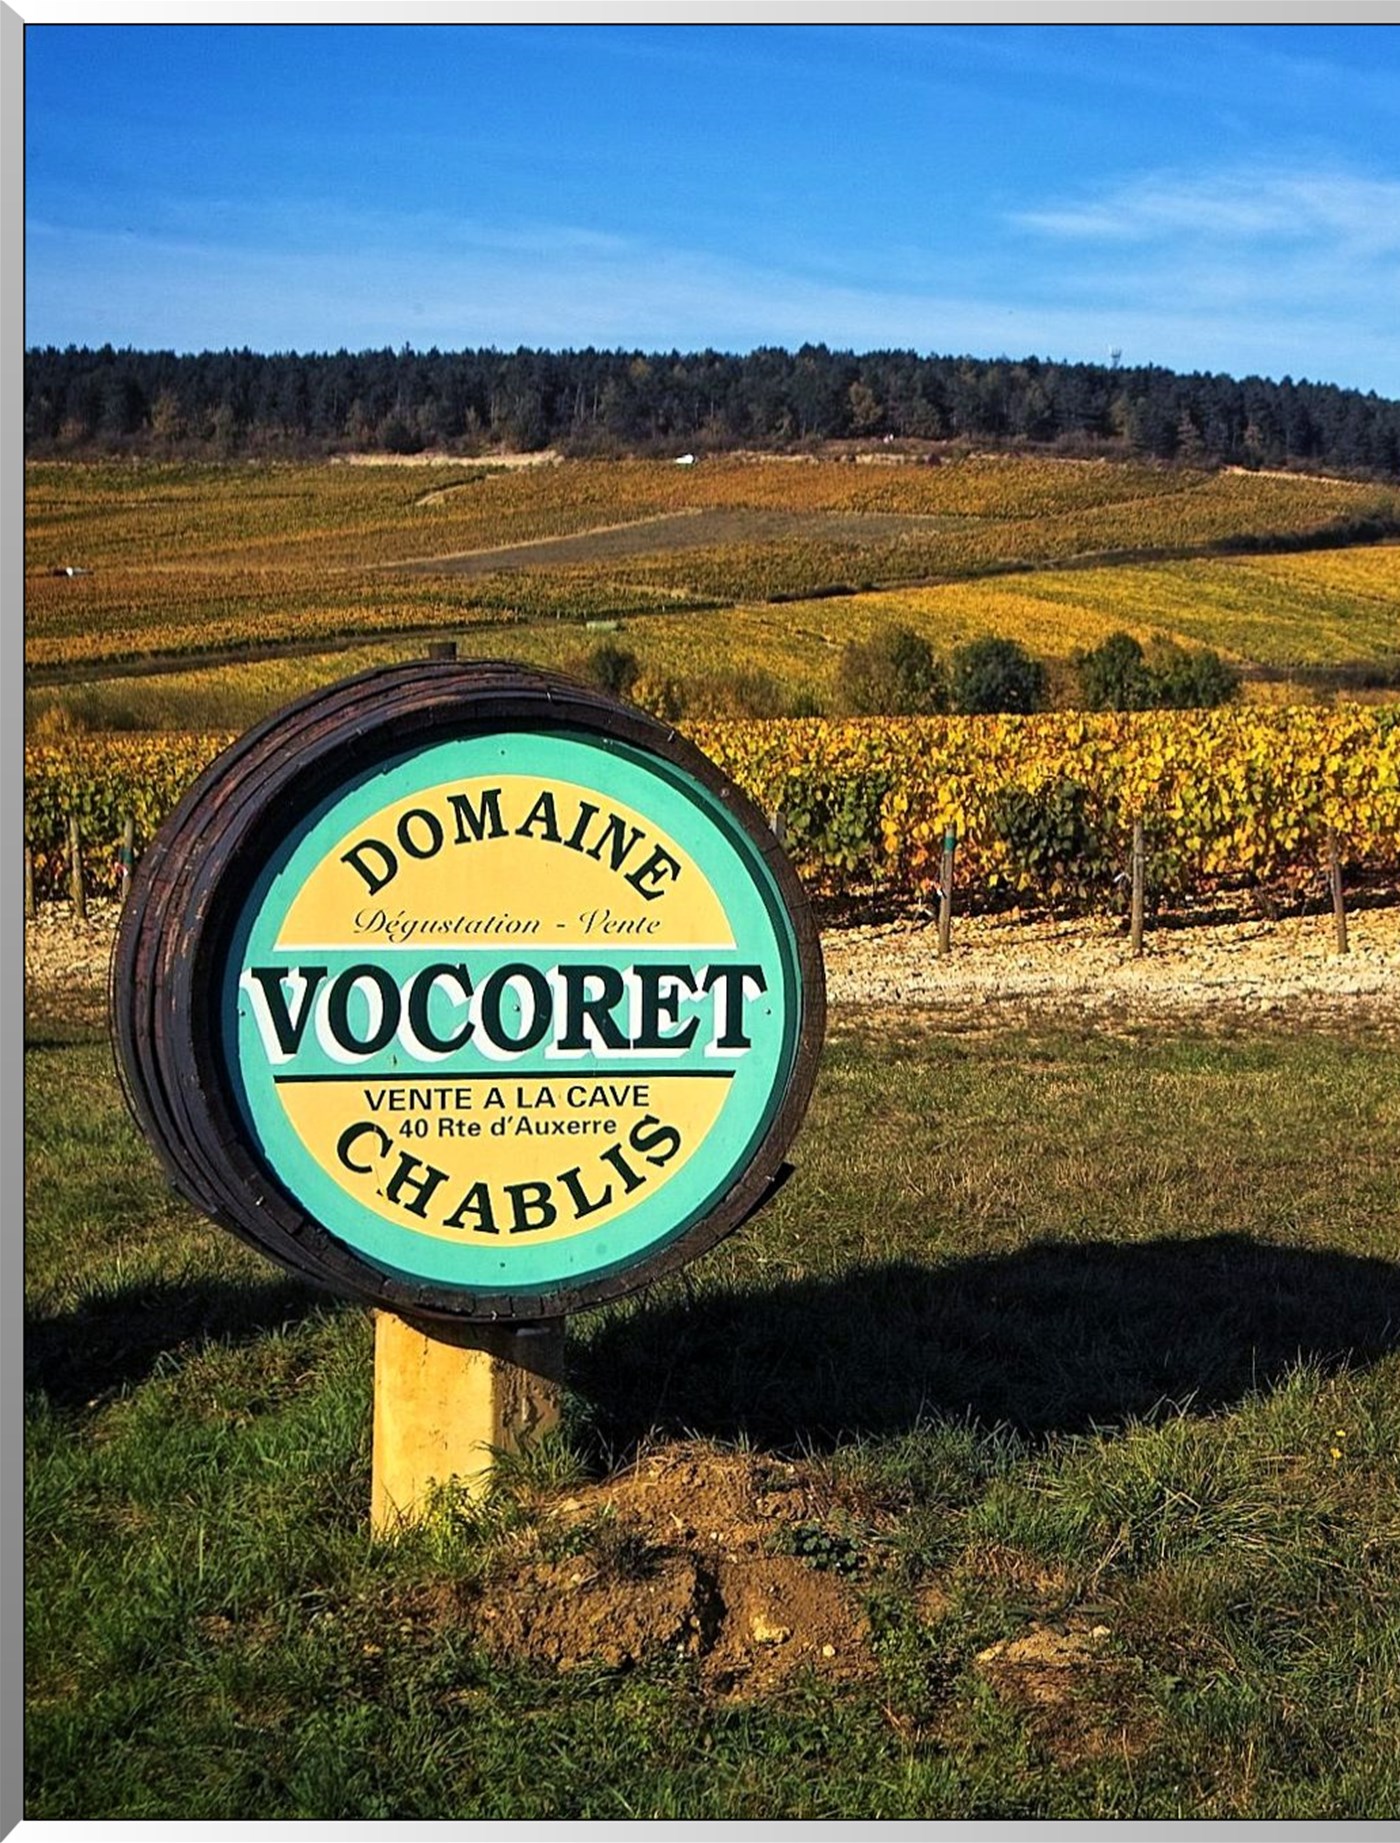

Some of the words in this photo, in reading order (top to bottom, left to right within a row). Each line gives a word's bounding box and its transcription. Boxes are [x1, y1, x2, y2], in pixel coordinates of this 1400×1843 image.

[340, 788, 682, 901] DOMAINE
[352, 908, 541, 943] Dégustation
[578, 909, 661, 936] Vente
[243, 962, 769, 1062] VOCORET
[364, 1088, 472, 1112] VENTE
[483, 1087, 506, 1110] A
[516, 1086, 556, 1110] LA
[566, 1084, 650, 1109] CAVE
[399, 1117, 429, 1138] 40
[437, 1116, 482, 1138] Rte
[490, 1115, 617, 1136] d'Auxerre
[336, 1114, 682, 1235] CHABLIS
